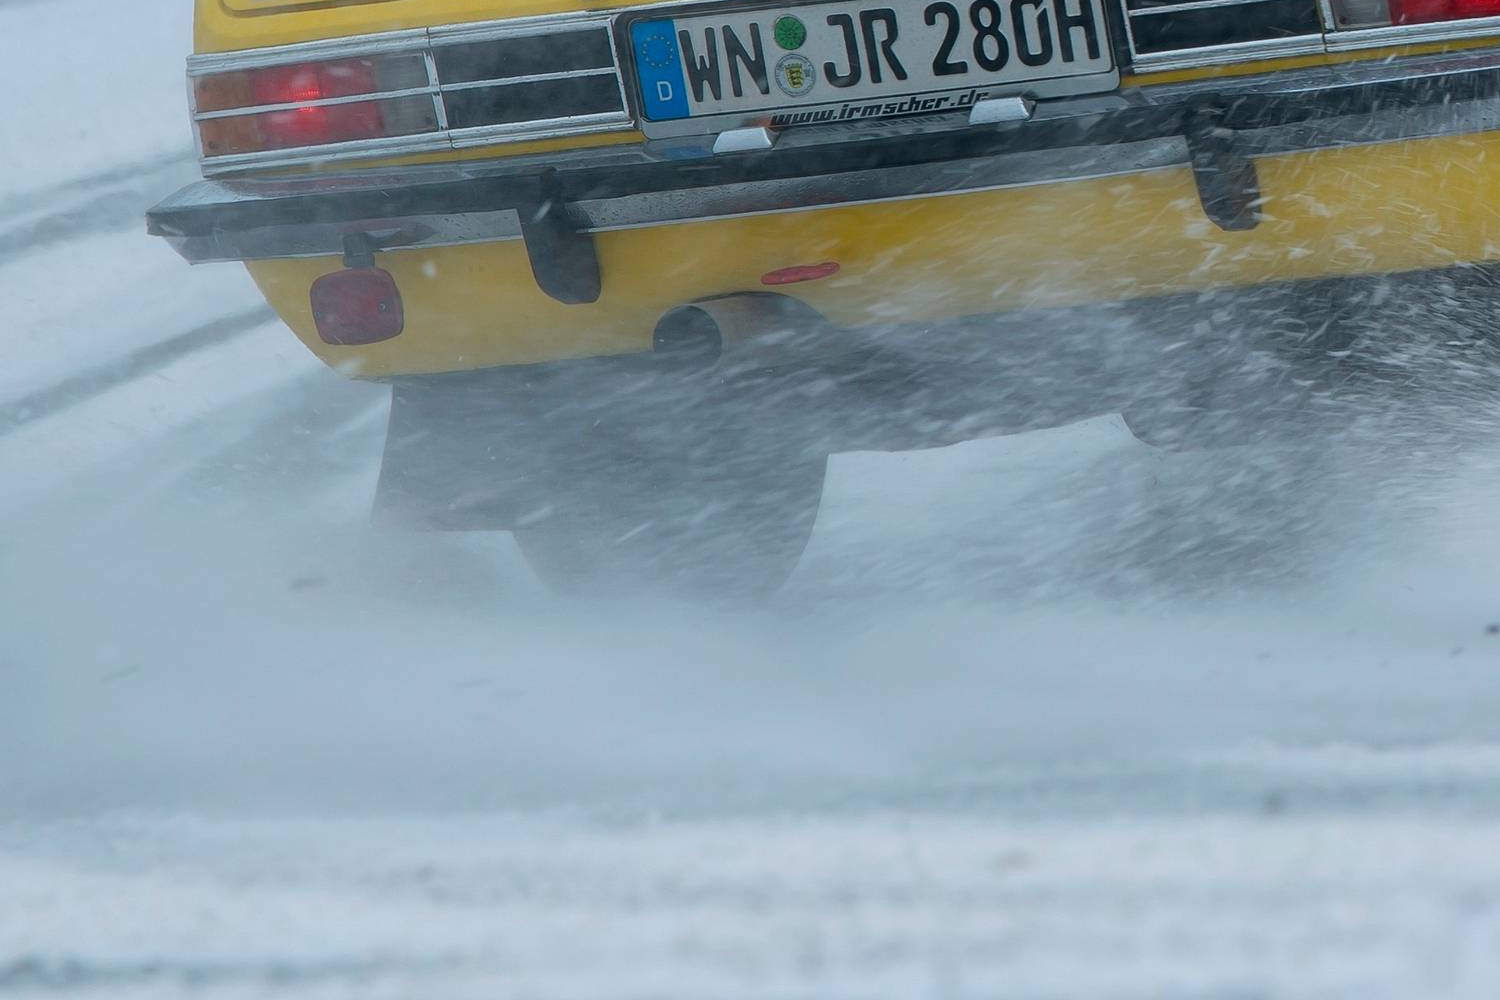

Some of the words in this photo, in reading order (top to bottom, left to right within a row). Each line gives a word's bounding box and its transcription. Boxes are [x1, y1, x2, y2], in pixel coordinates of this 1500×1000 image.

[678, 21, 771, 103] WN
[823, 7, 908, 89] JR
[656, 80, 673, 102] D
